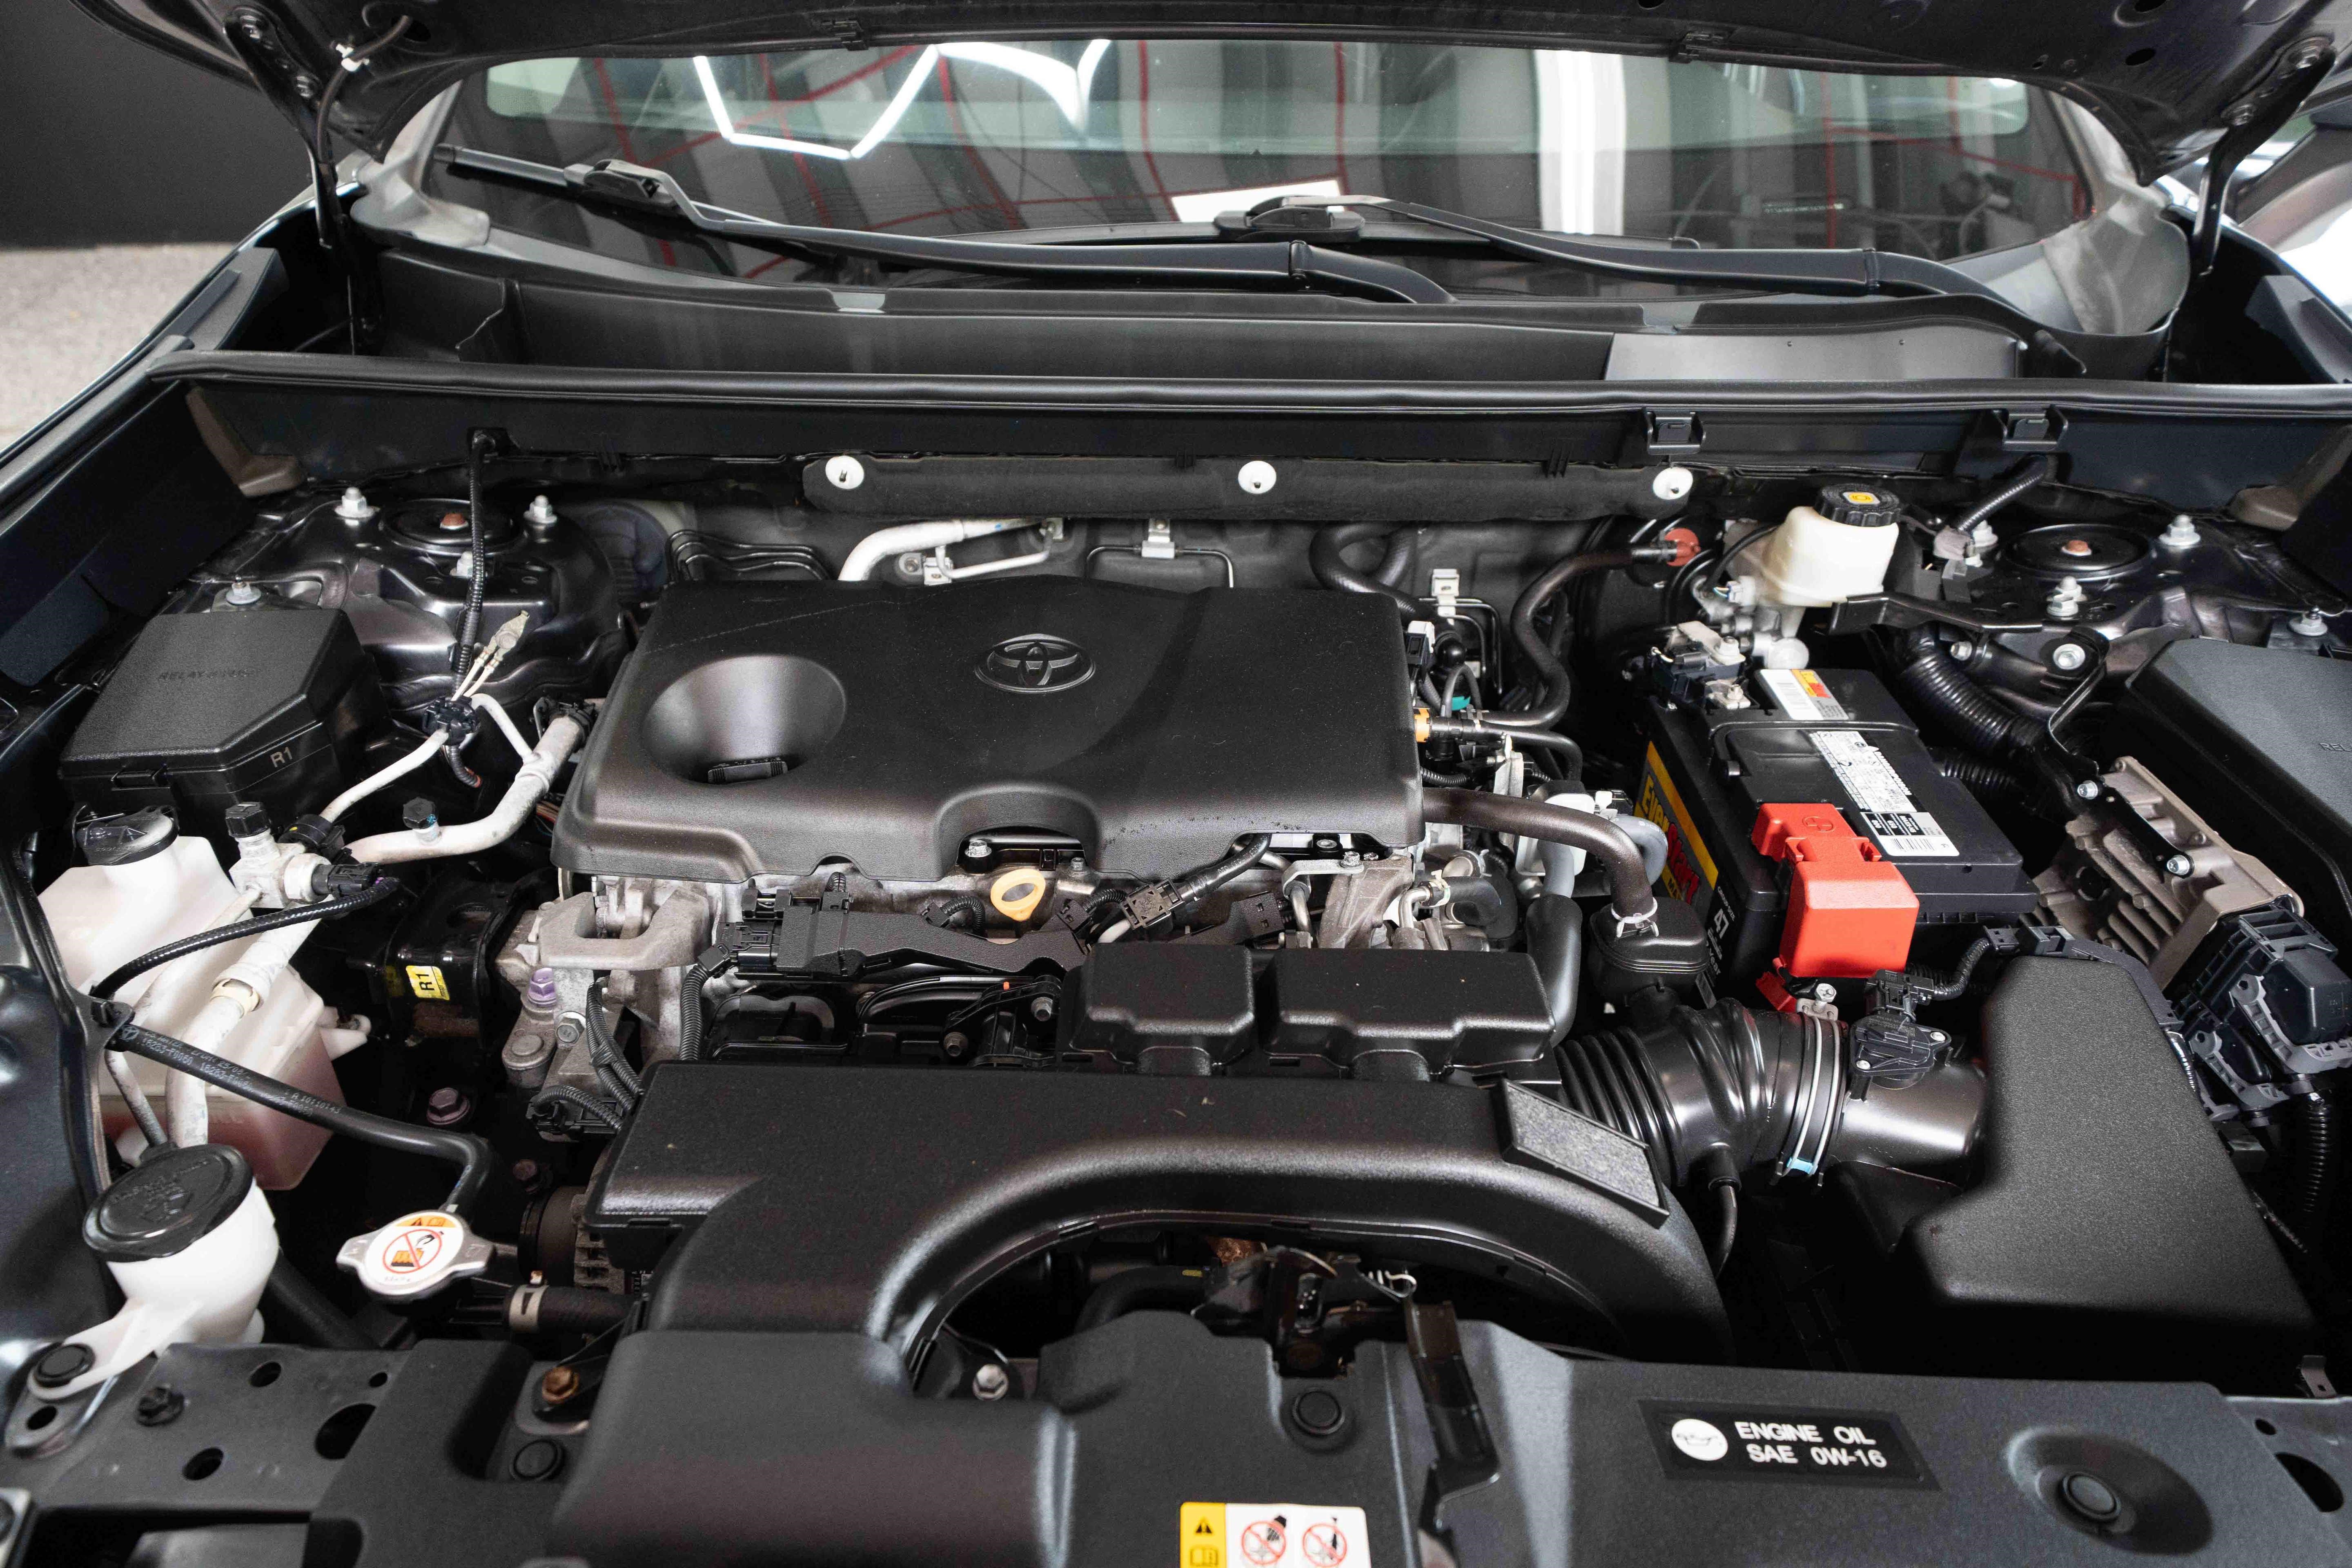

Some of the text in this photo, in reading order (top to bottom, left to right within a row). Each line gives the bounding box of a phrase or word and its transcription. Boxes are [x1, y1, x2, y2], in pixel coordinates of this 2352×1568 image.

[270, 746, 293, 768] R1
[2319, 742, 2352, 752] REL
[1713, 908, 1729, 939] 47
[415, 973, 435, 991] R1
[1734, 1421, 1877, 1446] ENGINE OIL
[1746, 1444, 1887, 1468] SAE 0W-16
